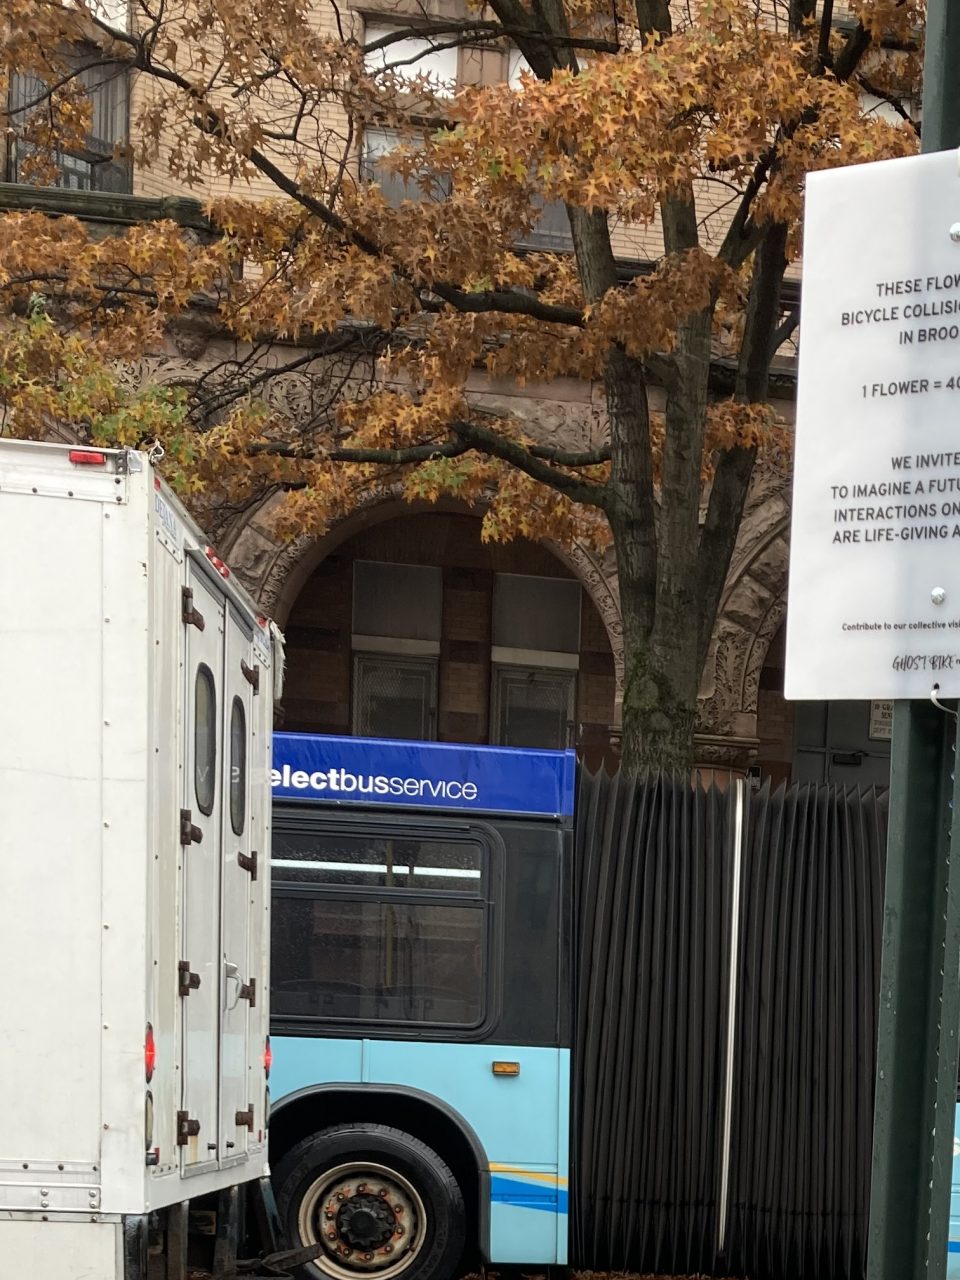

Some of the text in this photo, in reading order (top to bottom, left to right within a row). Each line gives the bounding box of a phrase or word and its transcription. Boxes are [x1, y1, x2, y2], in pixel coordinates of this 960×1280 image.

[876, 279, 922, 297] THESE
[841, 308, 899, 326] BICYCLE
[899, 331, 914, 345] IN
[861, 384, 868, 398] 1
[871, 379, 929, 397] FLOWER
[891, 456, 912, 470] WE
[831, 485, 849, 499] TO
[853, 481, 911, 498] IMAGINE
[915, 481, 924, 494] A
[834, 504, 937, 523] INTERACTIONS
[832, 530, 861, 544] ARE
[865, 525, 949, 542] LIFE-GIVING
[842, 621, 882, 632] Contribute
[883, 621, 892, 631] to
[893, 622, 907, 631] our
[908, 620, 946, 630] collective
[271, 764, 478, 801] electbusservice
